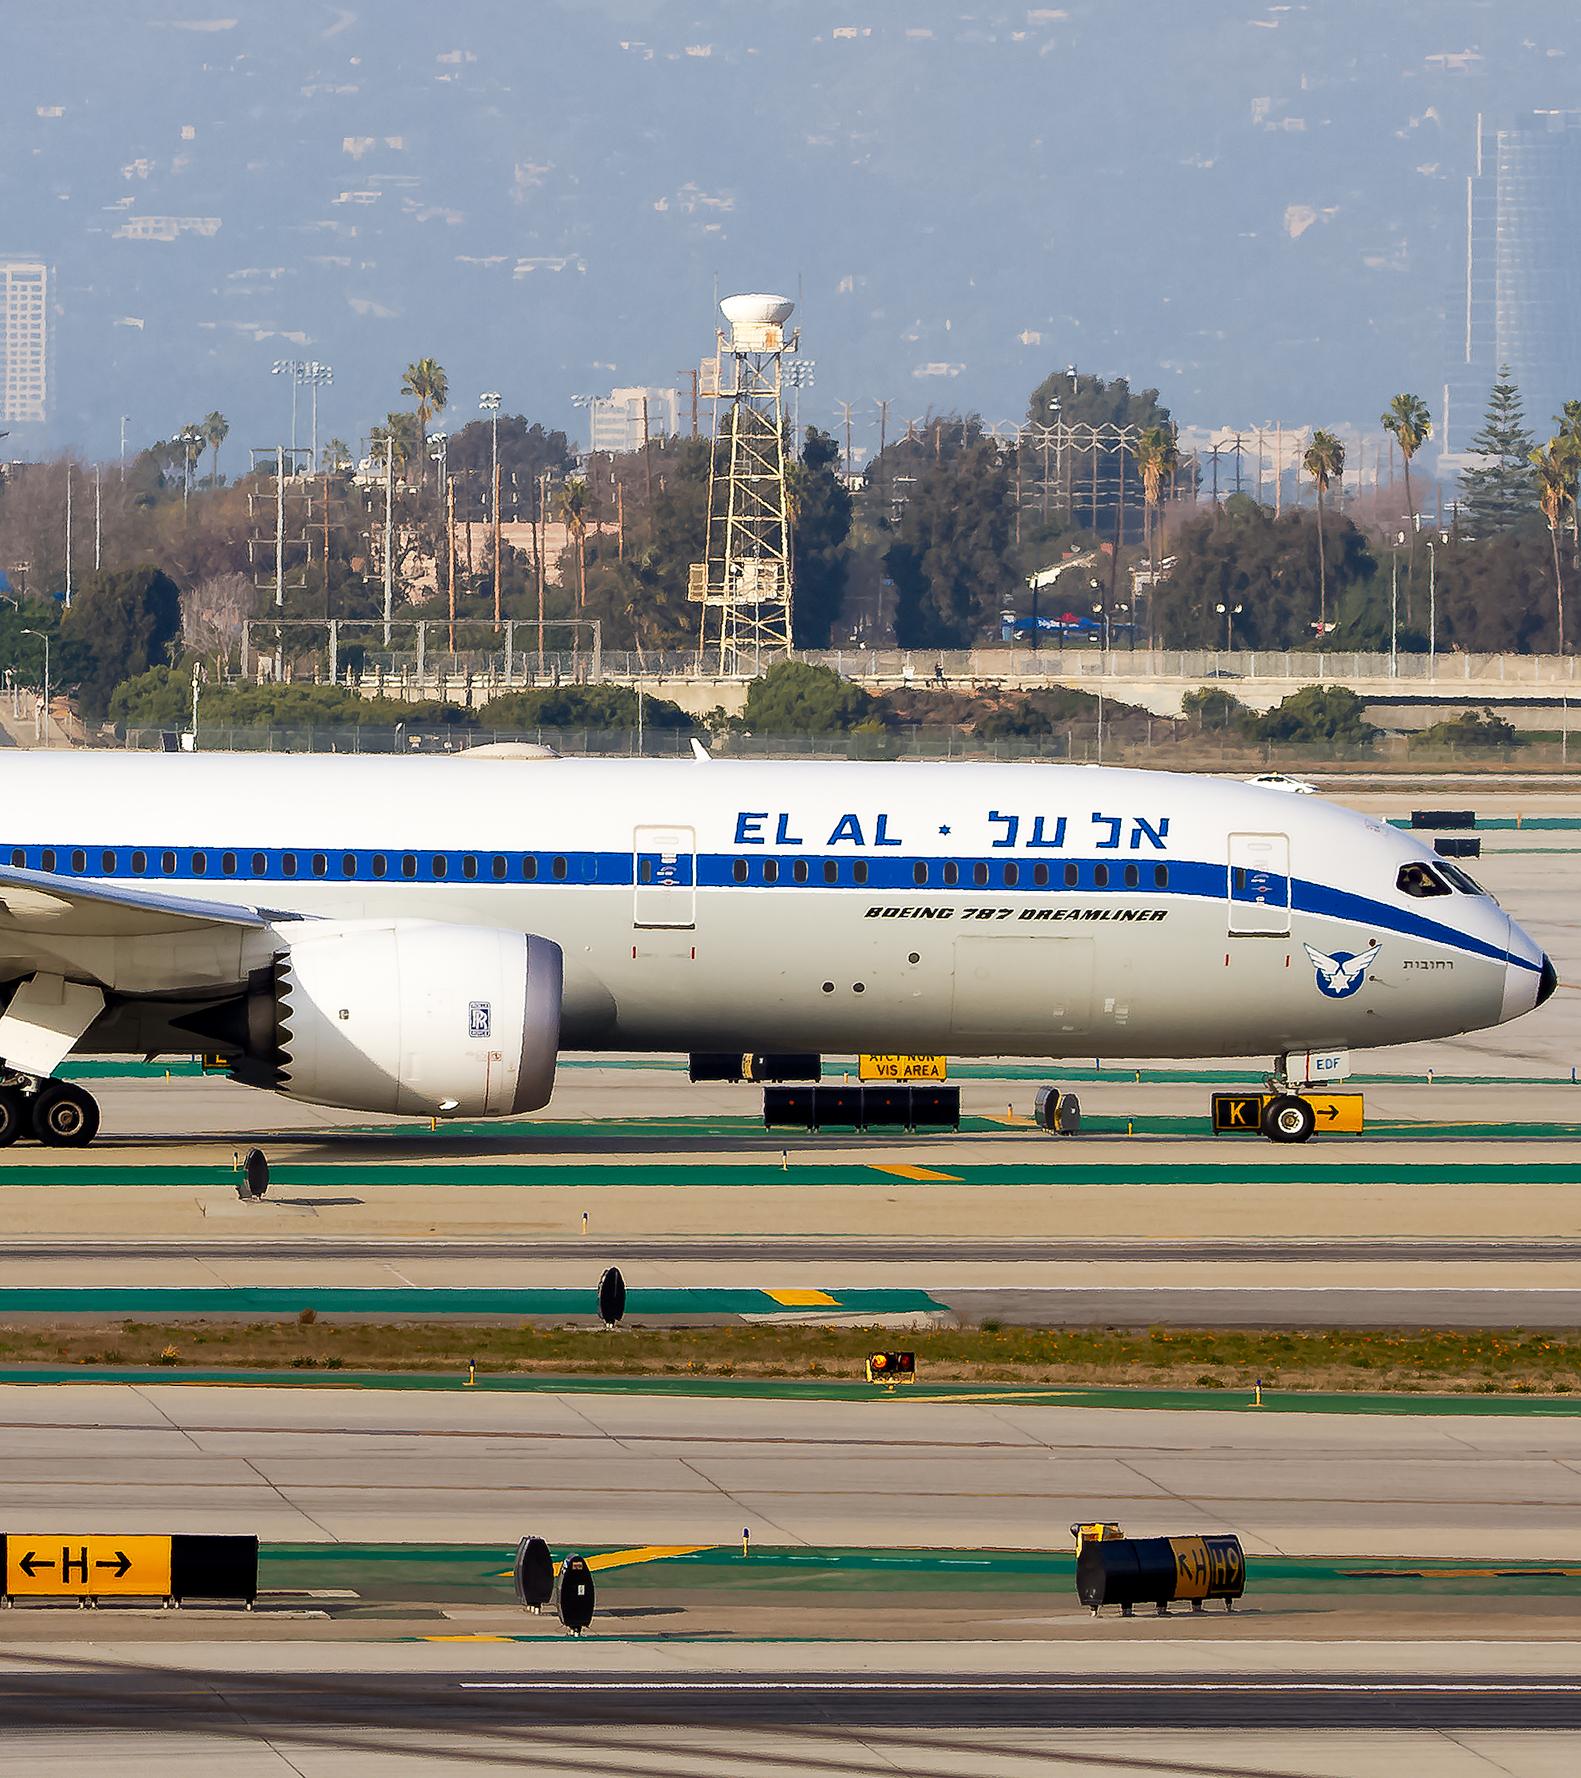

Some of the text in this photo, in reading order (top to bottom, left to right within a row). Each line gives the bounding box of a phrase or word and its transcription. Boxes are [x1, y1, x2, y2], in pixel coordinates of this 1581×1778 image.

[734, 811, 902, 846] EL AL
[987, 810, 1170, 849] אל על
[864, 906, 1168, 922] BOEING 787 DREAMLINER
[1402, 960, 1454, 970] רחובות
[876, 1064, 940, 1076] VIS AREA
[1316, 1057, 1341, 1071] EDF
[1229, 1101, 1247, 1125] K
[61, 1546, 89, 1584] H
[1211, 1546, 1240, 1586] H9
